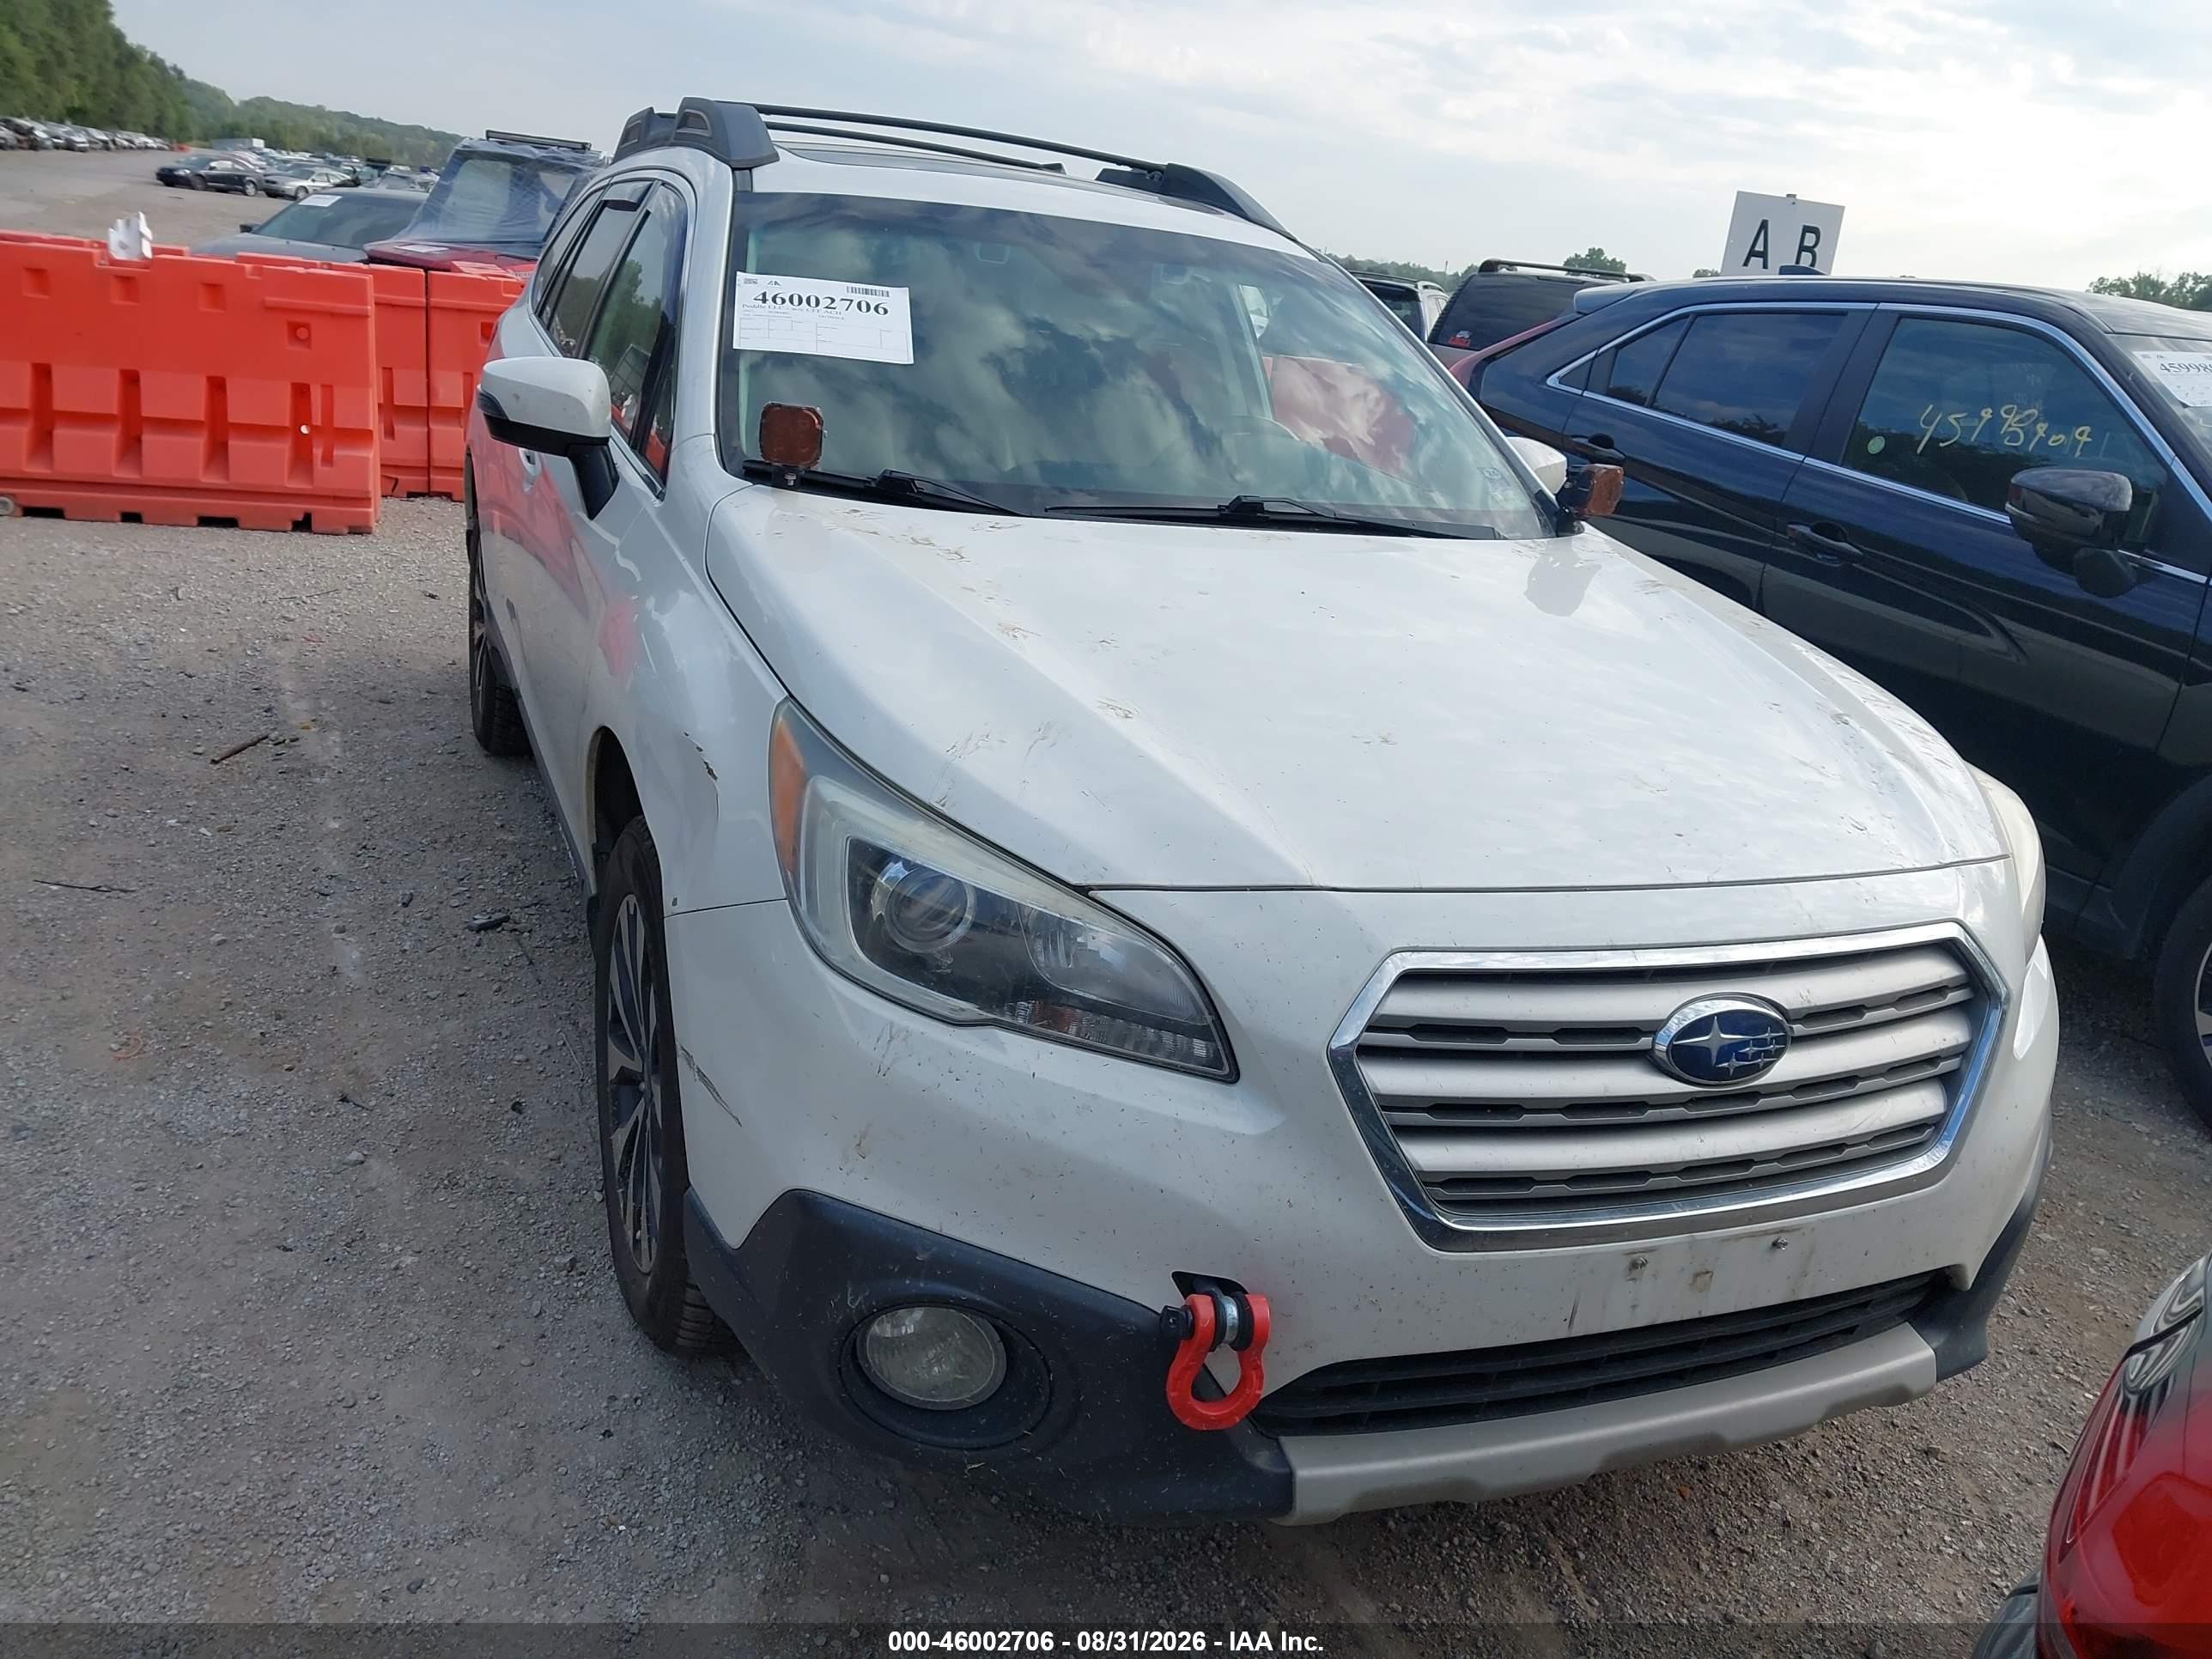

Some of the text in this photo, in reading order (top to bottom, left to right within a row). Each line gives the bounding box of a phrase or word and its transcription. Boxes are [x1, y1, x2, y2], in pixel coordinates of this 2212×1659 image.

[1741, 218, 1821, 270] A B
[753, 290, 890, 316] 46002706
[2160, 362, 2212, 373] 45998
